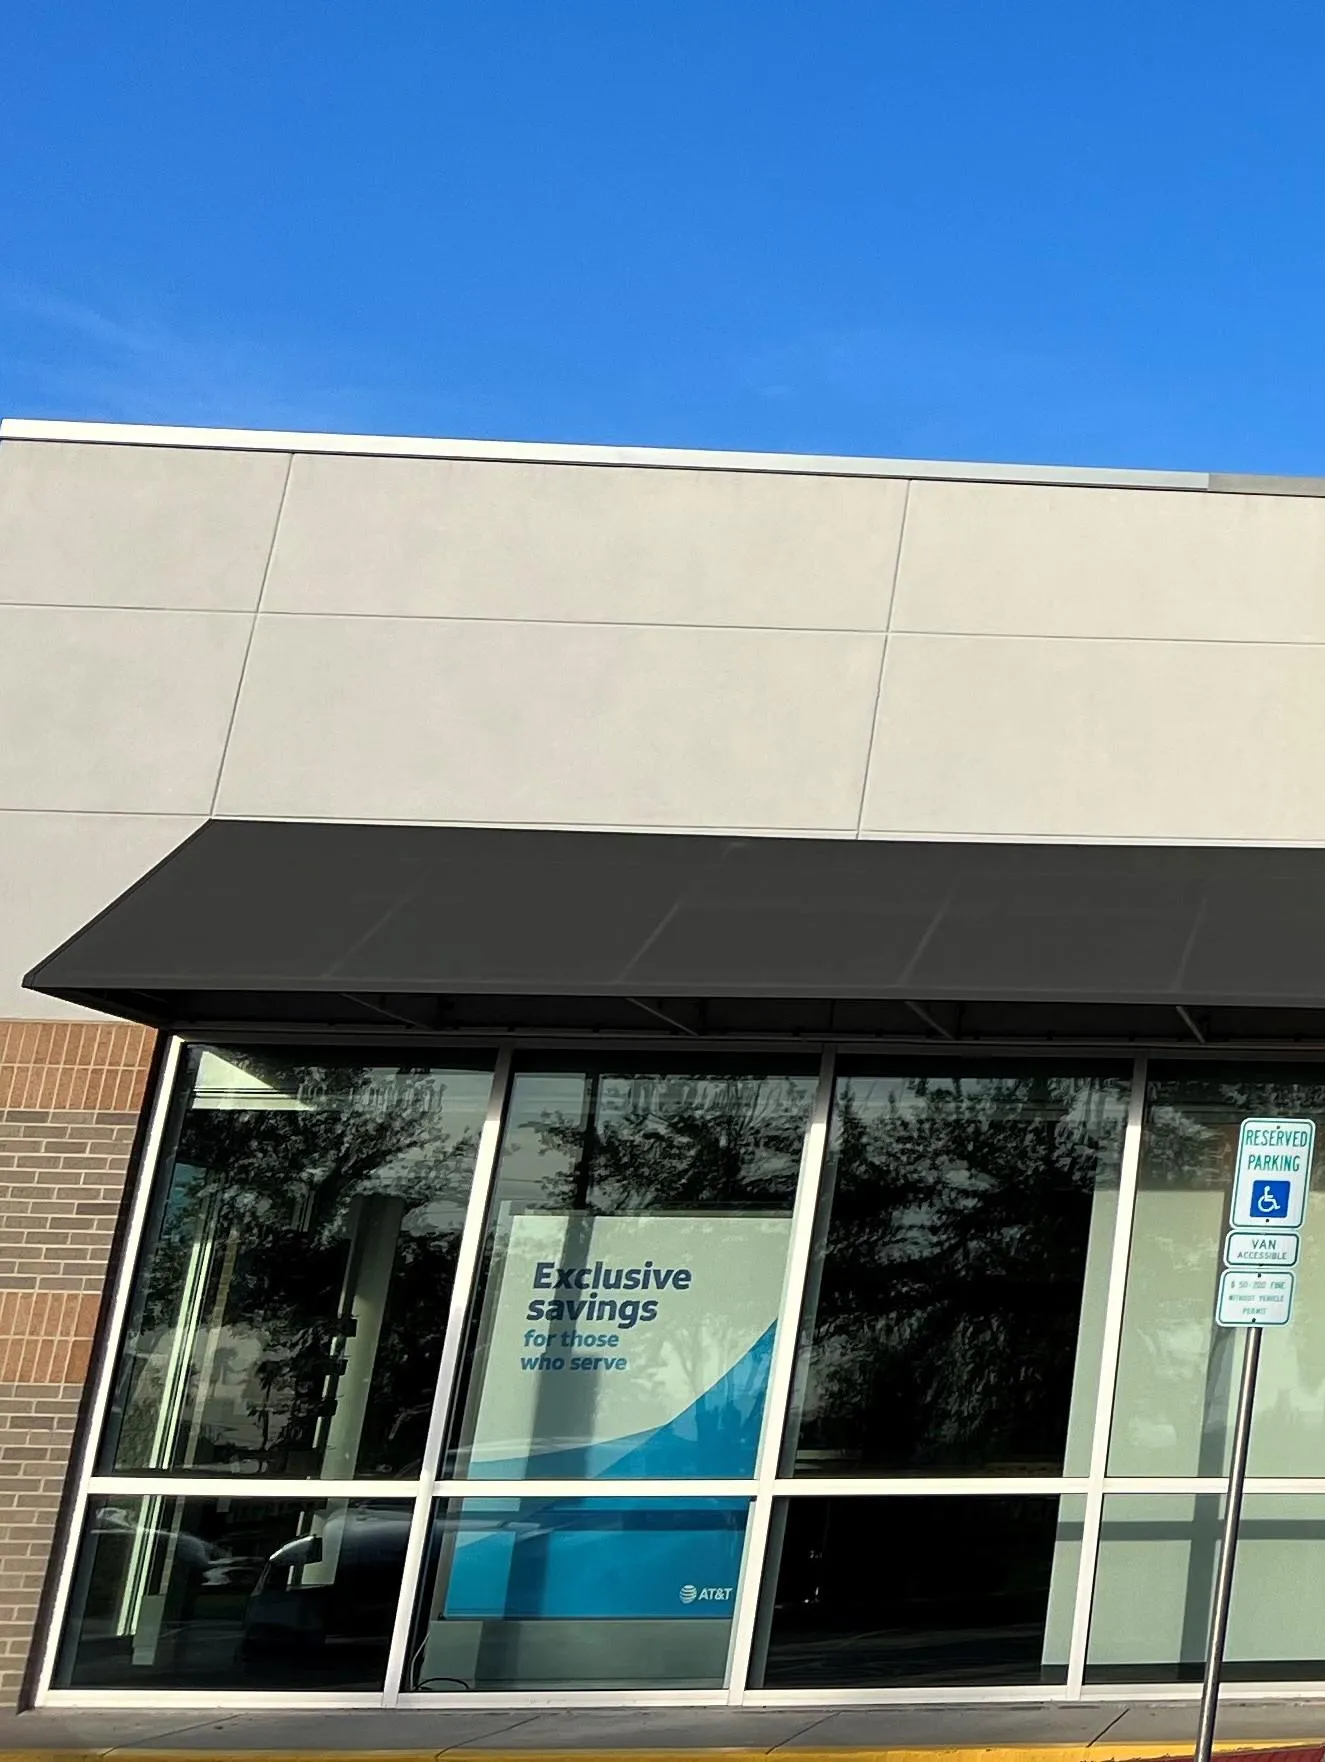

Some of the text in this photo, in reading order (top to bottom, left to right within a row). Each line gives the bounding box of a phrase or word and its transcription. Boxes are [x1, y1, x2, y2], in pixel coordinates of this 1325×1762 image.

[1245, 1130, 1308, 1147] RESERVED
[1248, 1154, 1301, 1171] PARKING
[1252, 1240, 1276, 1250] VAN
[1237, 1251, 1287, 1260] ACCESSIBLE
[532, 1261, 692, 1290] Exclusive
[526, 1292, 658, 1329] savings
[523, 1329, 619, 1347] for those
[520, 1352, 628, 1370] who serve
[698, 1588, 733, 1600] AT&T
